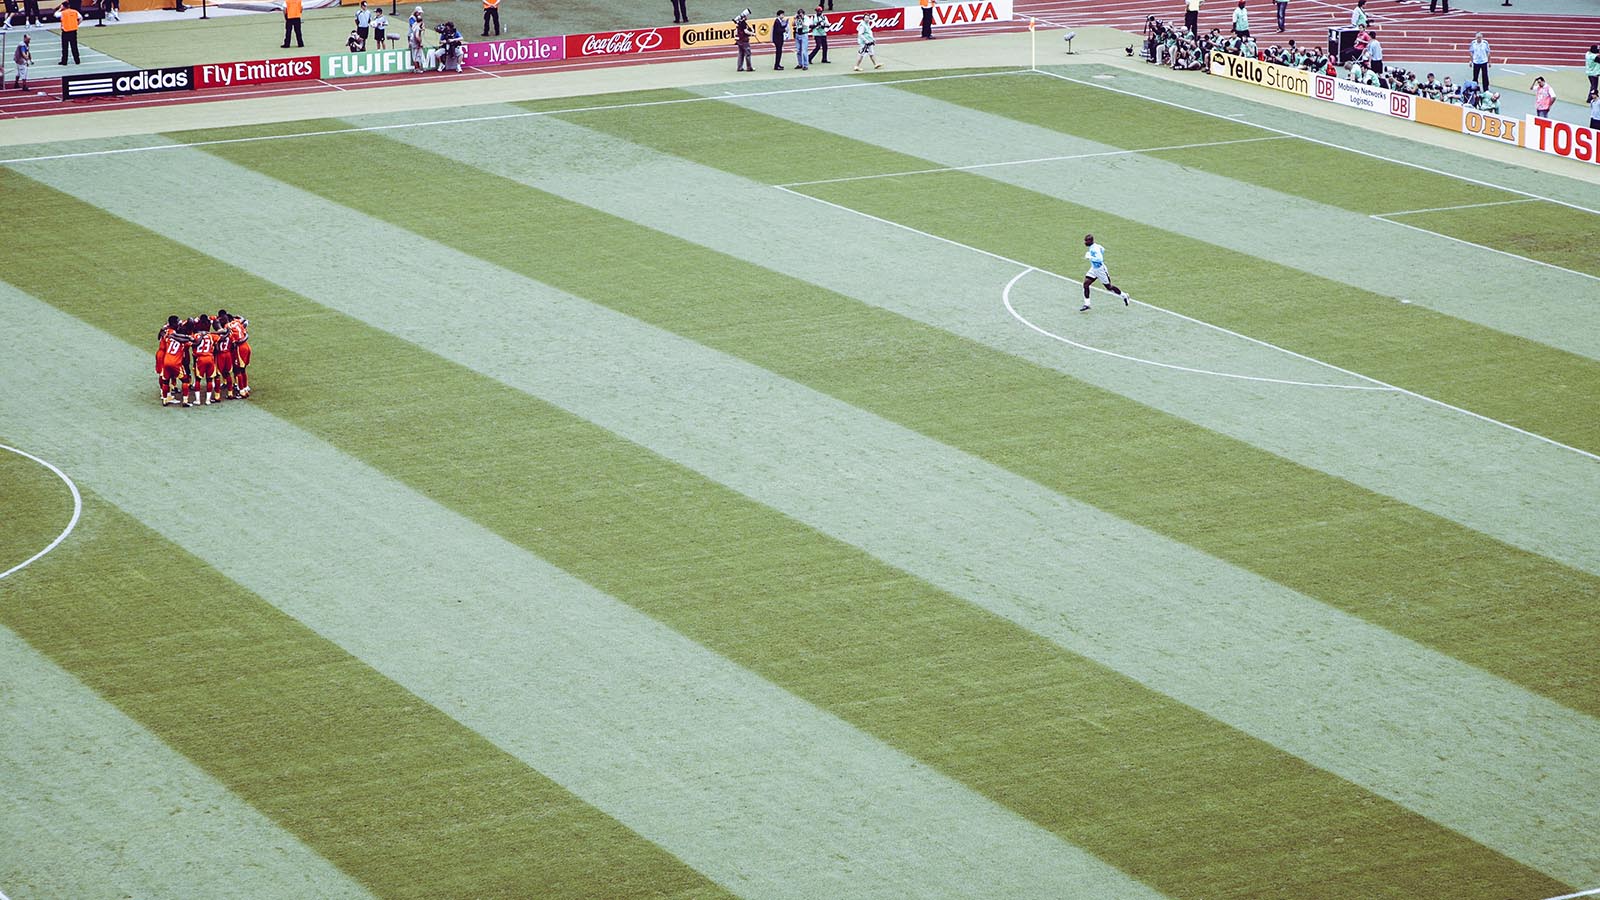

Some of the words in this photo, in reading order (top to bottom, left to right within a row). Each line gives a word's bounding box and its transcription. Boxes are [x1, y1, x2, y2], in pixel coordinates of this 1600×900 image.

[116, 69, 189, 91] adidas
[202, 65, 232, 86] Fly
[235, 60, 313, 81] Emirates
[1227, 56, 1263, 82] Yello
[1266, 65, 1309, 94] Strom
[1317, 78, 1333, 97] DB
[1338, 82, 1360, 94] Mobility
[1361, 87, 1387, 100] Networks
[1350, 95, 1374, 106] Logistics
[1392, 95, 1408, 114] DB
[1465, 111, 1517, 141] OBI
[1534, 117, 1600, 165] TOS
[167, 338, 180, 355] 19
[196, 338, 210, 353] 23
